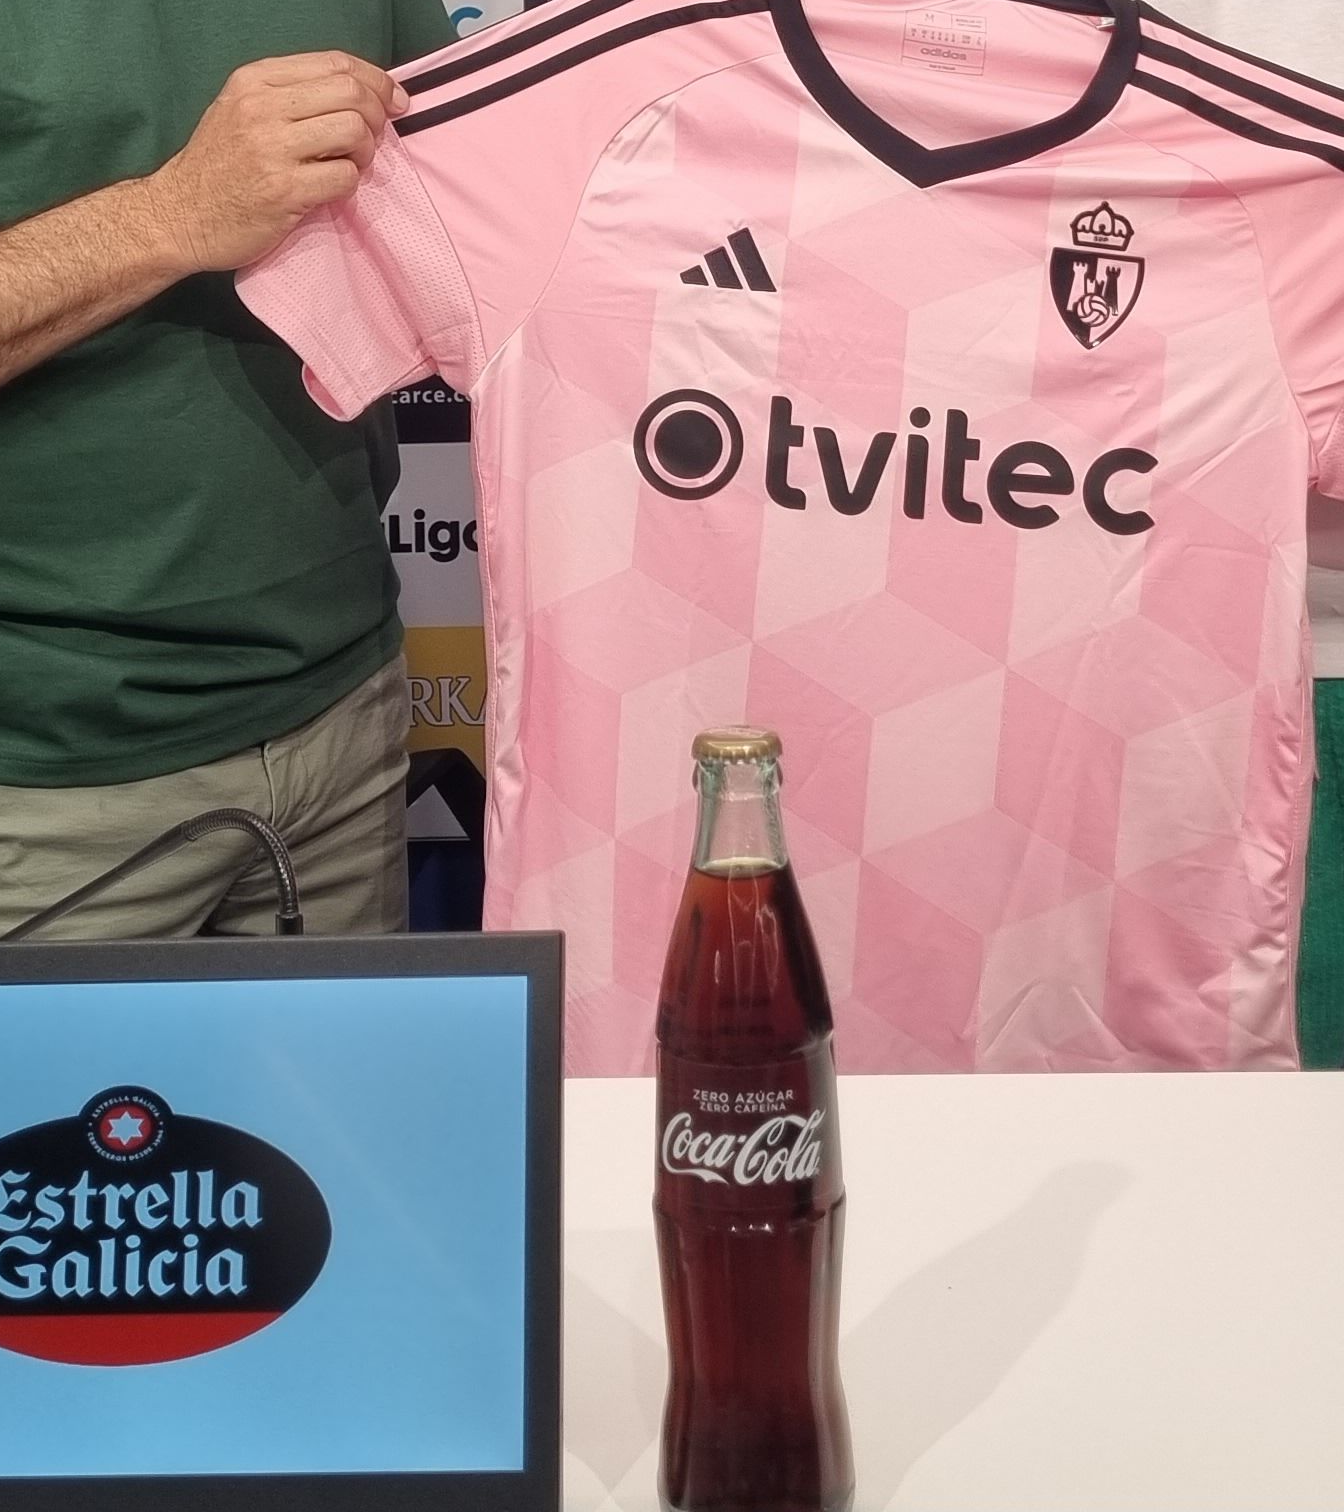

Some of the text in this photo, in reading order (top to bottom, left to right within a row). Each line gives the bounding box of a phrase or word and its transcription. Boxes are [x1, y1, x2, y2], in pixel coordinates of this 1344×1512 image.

[920, 47, 967, 61] adidas
[766, 395, 1159, 536] tvitec
[693, 1089, 794, 1103] ZERO AZÚCAR
[699, 1101, 730, 1113] ZERO
[662, 1108, 826, 1185] Coca-Cola
